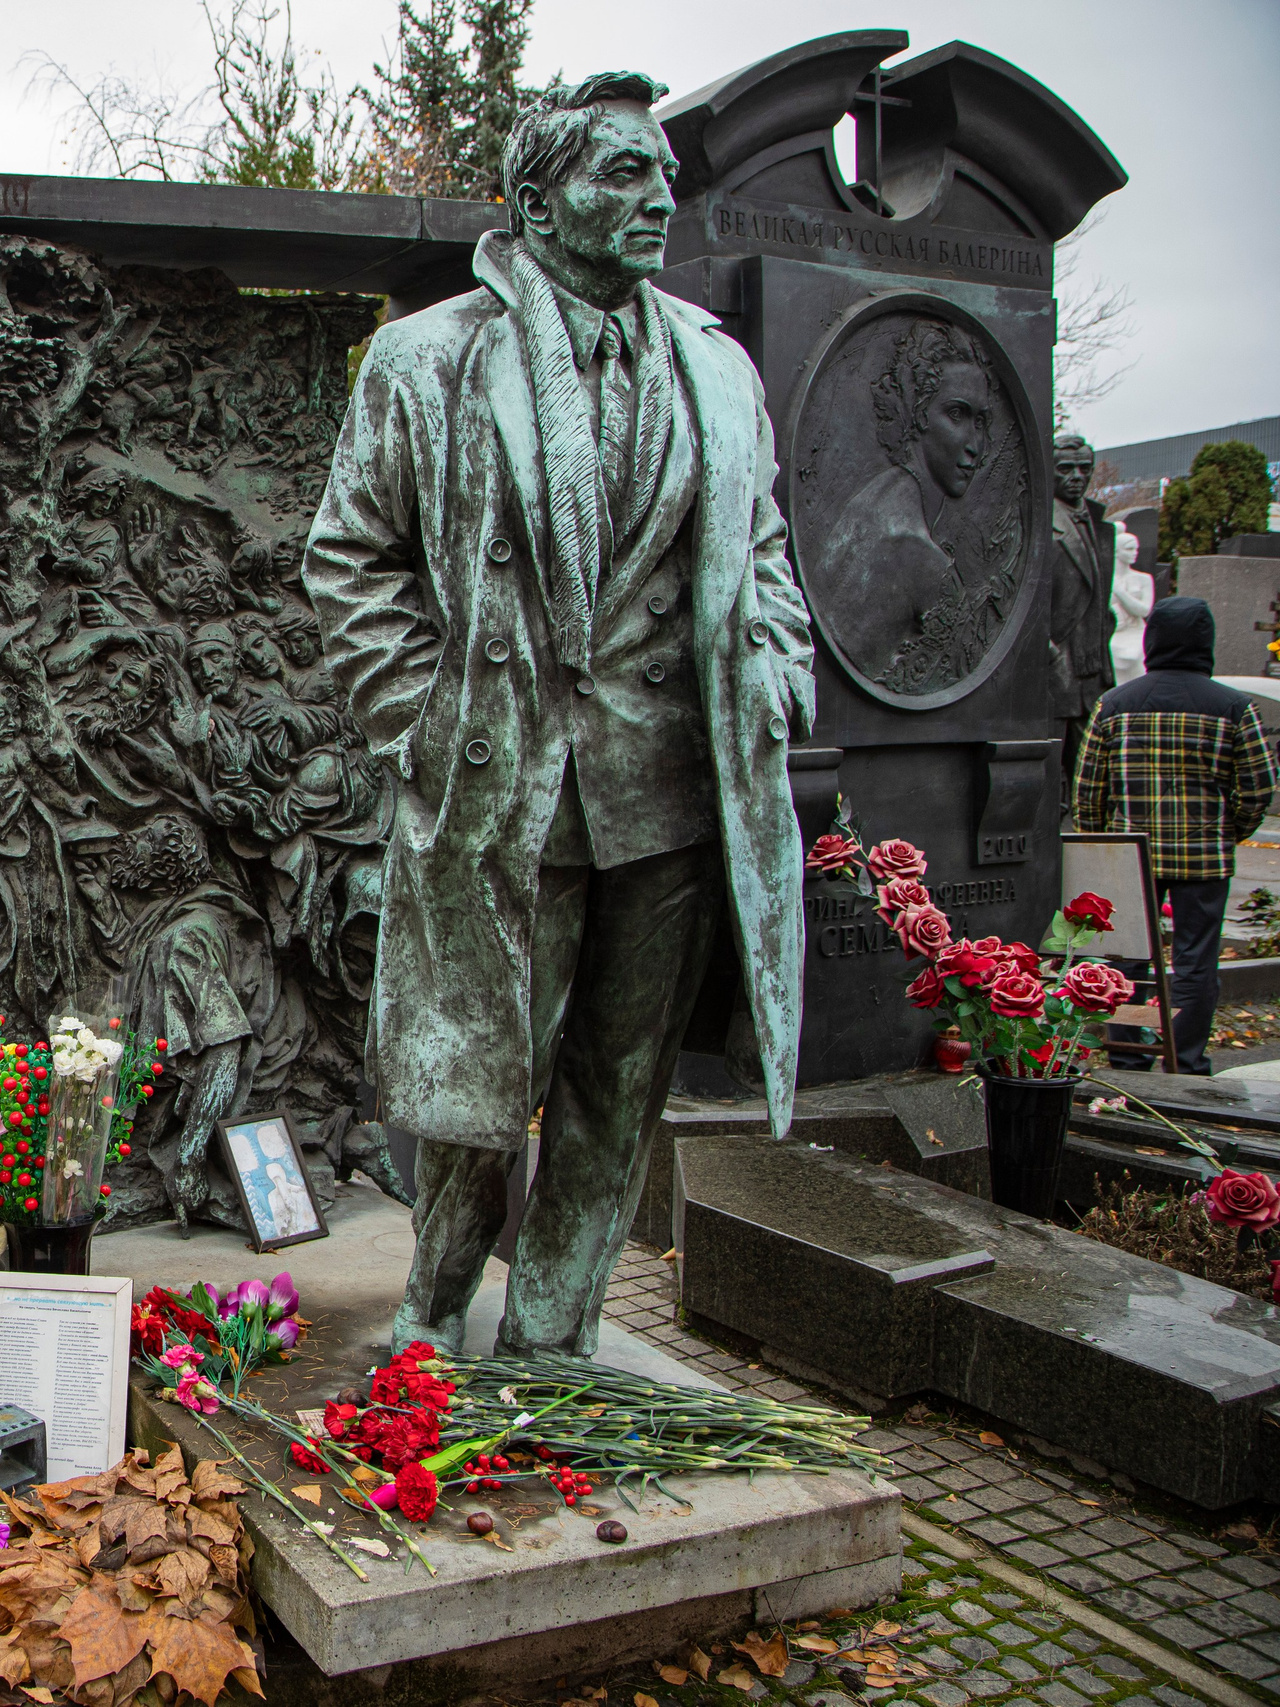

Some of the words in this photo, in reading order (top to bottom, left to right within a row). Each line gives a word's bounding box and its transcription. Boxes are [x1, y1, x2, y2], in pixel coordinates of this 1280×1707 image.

[719, 208, 823, 250] ВЕЛИКАЯ
[833, 224, 929, 264] РУССКАЯ
[938, 240, 1044, 278] БАЛЕРИНА
[983, 834, 1027, 858] 2010
